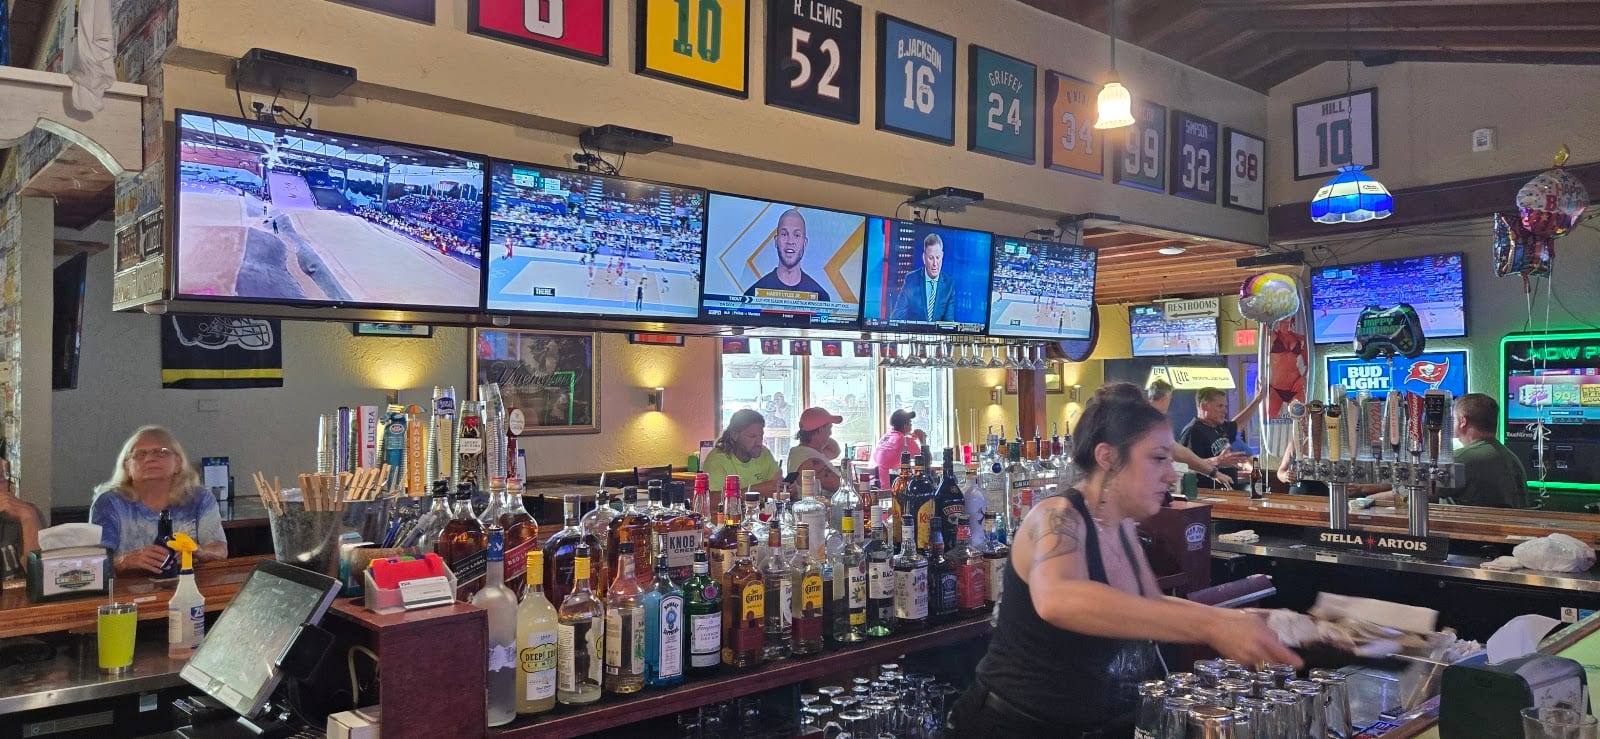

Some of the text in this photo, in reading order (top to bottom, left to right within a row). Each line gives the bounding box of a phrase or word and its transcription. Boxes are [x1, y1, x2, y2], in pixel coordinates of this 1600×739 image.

[793, 0, 842, 29] R. LEWIS
[673, 0, 723, 63] 10
[789, 26, 841, 99] 52
[897, 39, 942, 72] B.JACKSON
[903, 60, 935, 115] 16
[988, 71, 1023, 94] GRIFFEY
[987, 92, 1022, 135] 24
[1321, 100, 1345, 117] HILL
[1061, 111, 1094, 155] 34
[1185, 119, 1208, 139] SIMPSON
[1124, 124, 1159, 179] 99
[1315, 118, 1352, 167] 10
[1182, 143, 1210, 192] 32
[1235, 149, 1258, 182] 38
[1167, 299, 1217, 313] RESTROOMS
[1529, 346, 1600, 360] NOW P
[1154, 367, 1165, 376] Lite
[1172, 369, 1190, 385] Lite
[1347, 366, 1383, 378] BUD
[1341, 377, 1390, 390] LIGHT
[368, 410, 376, 443] ULTRA
[669, 535, 695, 549] KNOB
[1319, 532, 1428, 551] STELLA ARTOIS
[508, 557, 519, 565] RED
[525, 652, 542, 662] DEEP
